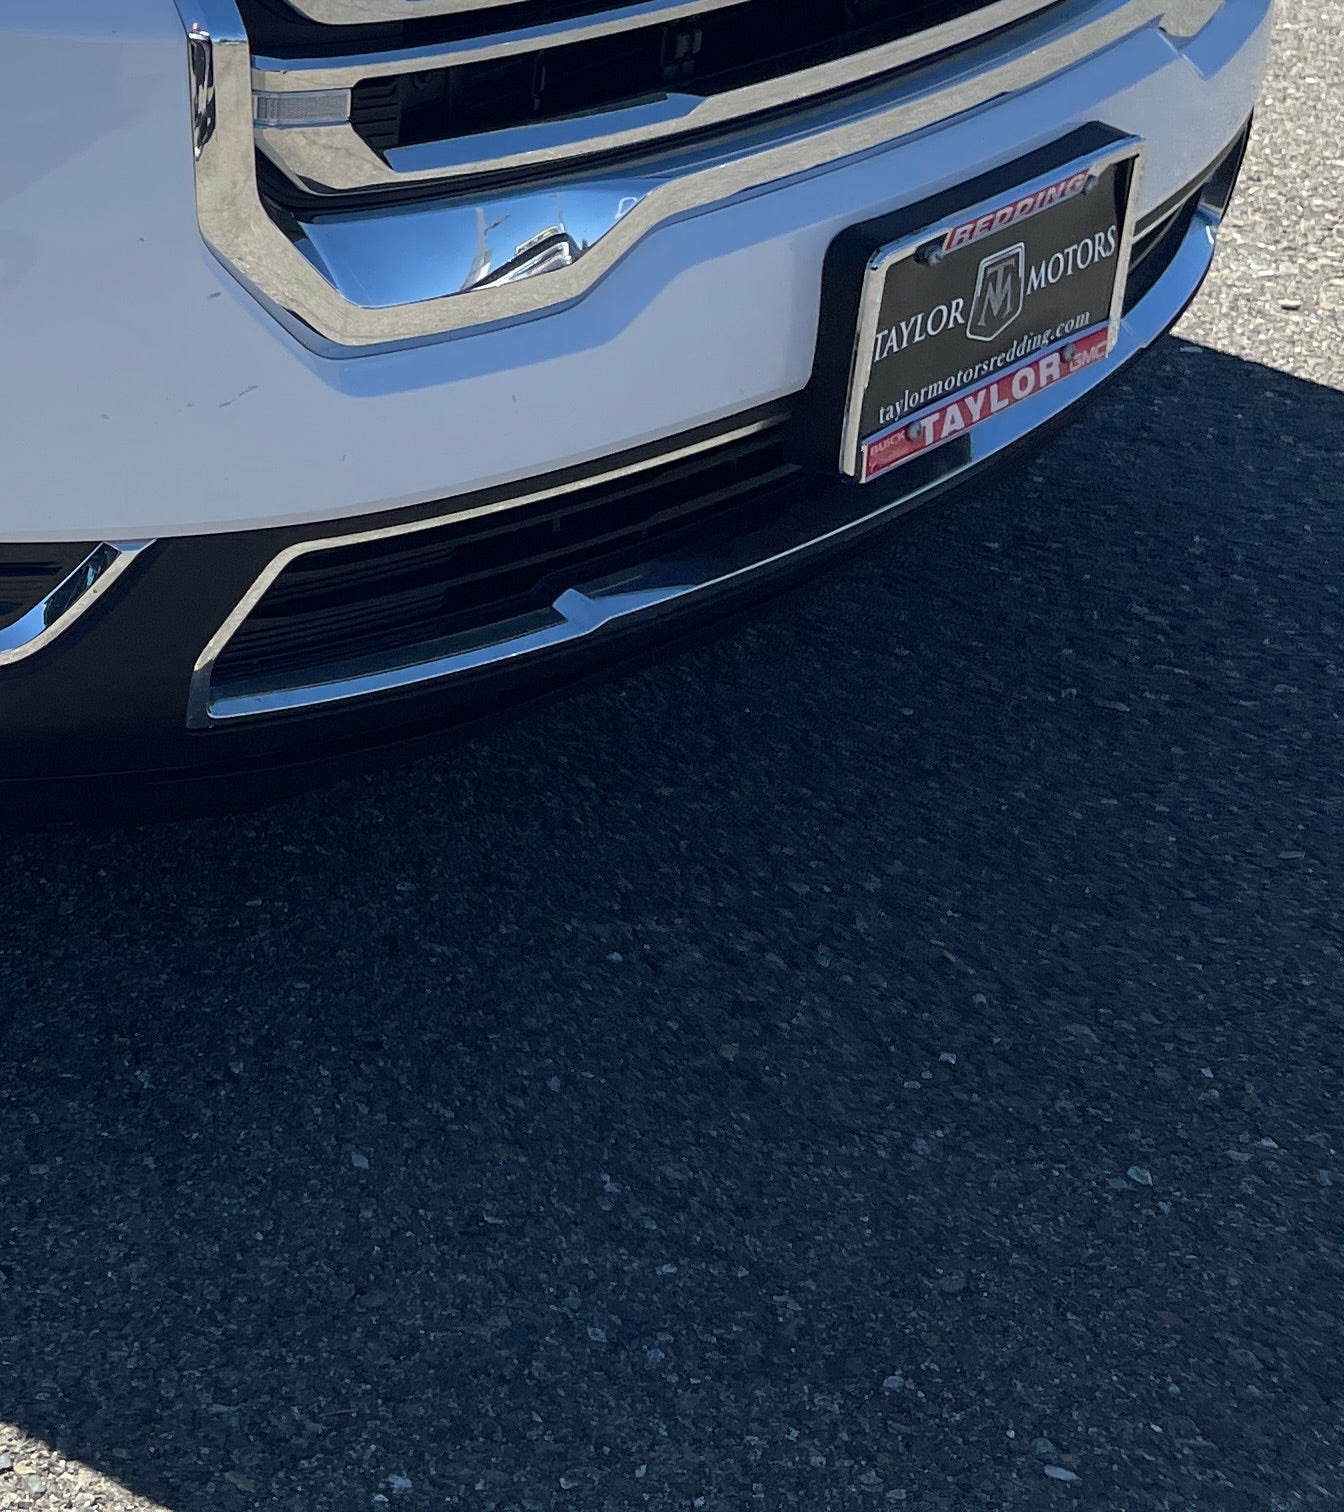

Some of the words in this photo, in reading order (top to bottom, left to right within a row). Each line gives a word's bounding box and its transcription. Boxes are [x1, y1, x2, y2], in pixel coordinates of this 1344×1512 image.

[949, 173, 1087, 249] REDDING
[874, 297, 966, 363] TAYLOR
[1025, 224, 1117, 297] MOTORS
[879, 311, 1091, 425] taylormotorsredding.com
[919, 351, 1062, 446] TAYLOR
